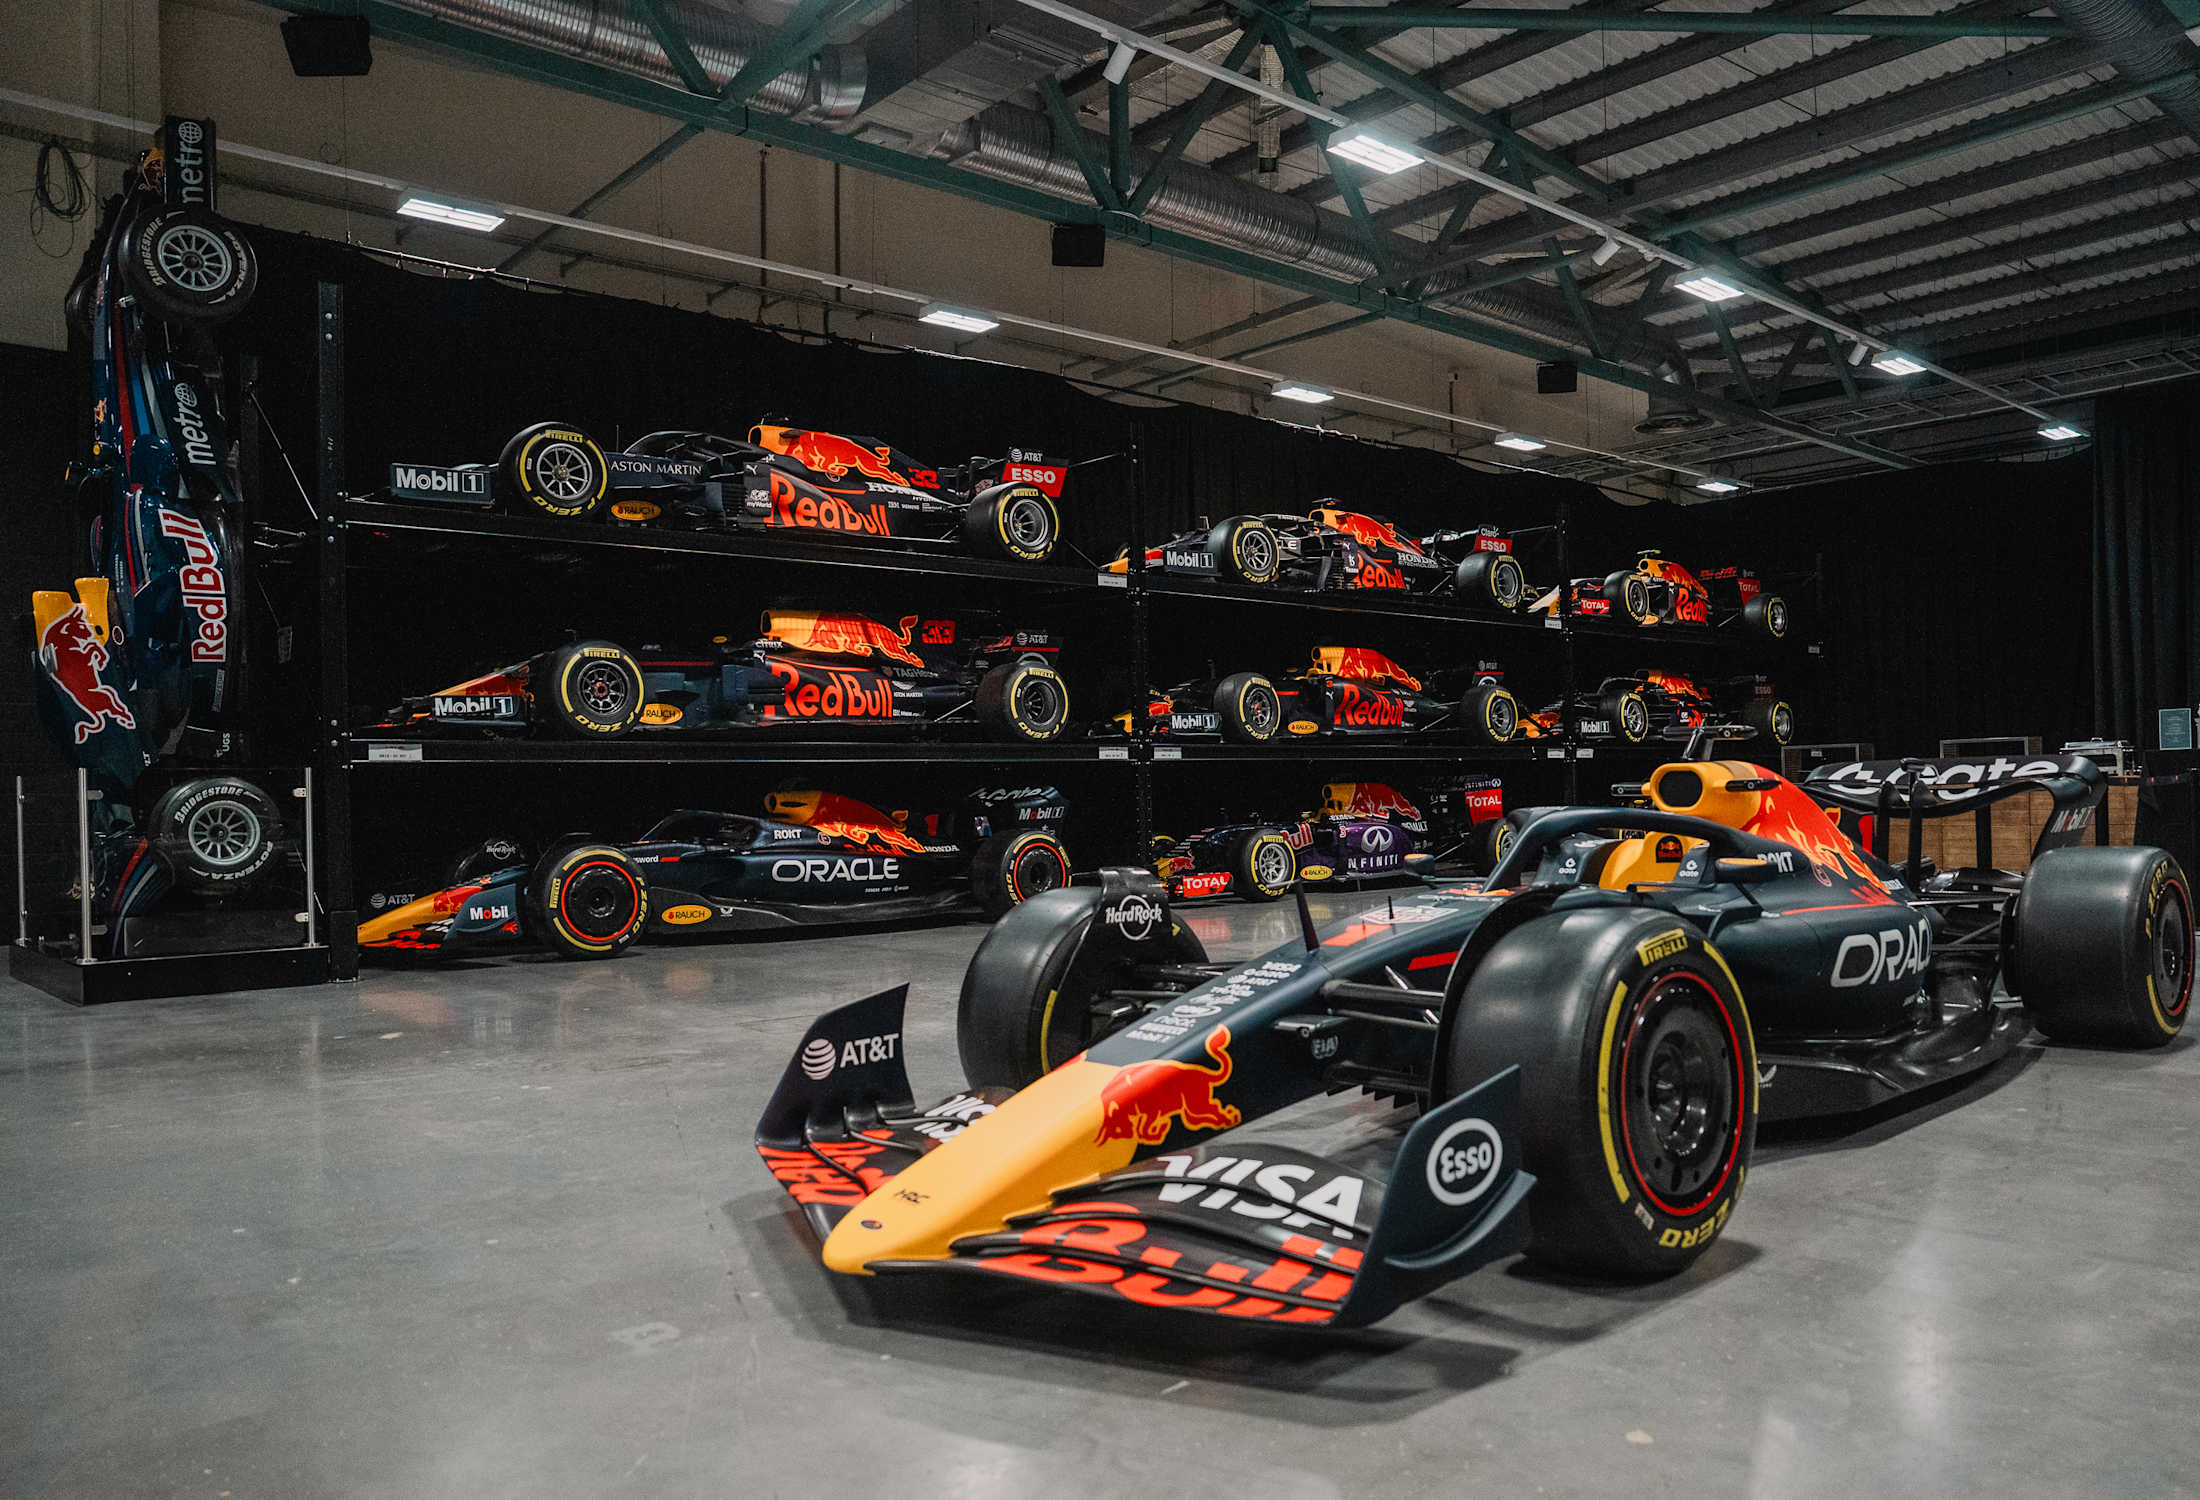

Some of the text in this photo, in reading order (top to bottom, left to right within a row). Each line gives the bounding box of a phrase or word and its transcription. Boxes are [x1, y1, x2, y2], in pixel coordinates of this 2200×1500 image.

[545, 429, 584, 443] PIRELLI
[1023, 452, 1042, 462] AT&T
[611, 461, 702, 475] ASTON MARTIN
[396, 468, 459, 492] Mobil
[1011, 467, 1056, 484] ESSO
[1480, 541, 1507, 552] ESSO
[1166, 550, 1199, 567] Mobil
[1581, 599, 1608, 610] TOTAL
[1028, 633, 1048, 643] AT&T
[434, 697, 492, 716] Mobil
[1172, 715, 1203, 729] Mobil
[1581, 721, 1599, 733] Mobil
[174, 786, 244, 824] BRIDGESTONE
[1466, 794, 1502, 808] TOTAL
[1018, 808, 1052, 821] Mobil
[774, 829, 802, 840] ROKT
[924, 845, 960, 853] HONDA
[633, 856, 658, 864] sword
[1347, 854, 1399, 869] NFINITI
[771, 858, 900, 883] ORACLE
[1184, 876, 1229, 889] TOTAL
[387, 893, 415, 905] AT&T
[469, 906, 509, 922] Mobil
[675, 911, 706, 921] RAUCH
[1636, 928, 1688, 967] PIRELLI
[840, 1033, 899, 1069] AT&T
[1440, 1140, 1493, 1185] Esso
[1156, 1155, 1365, 1240] VISA
